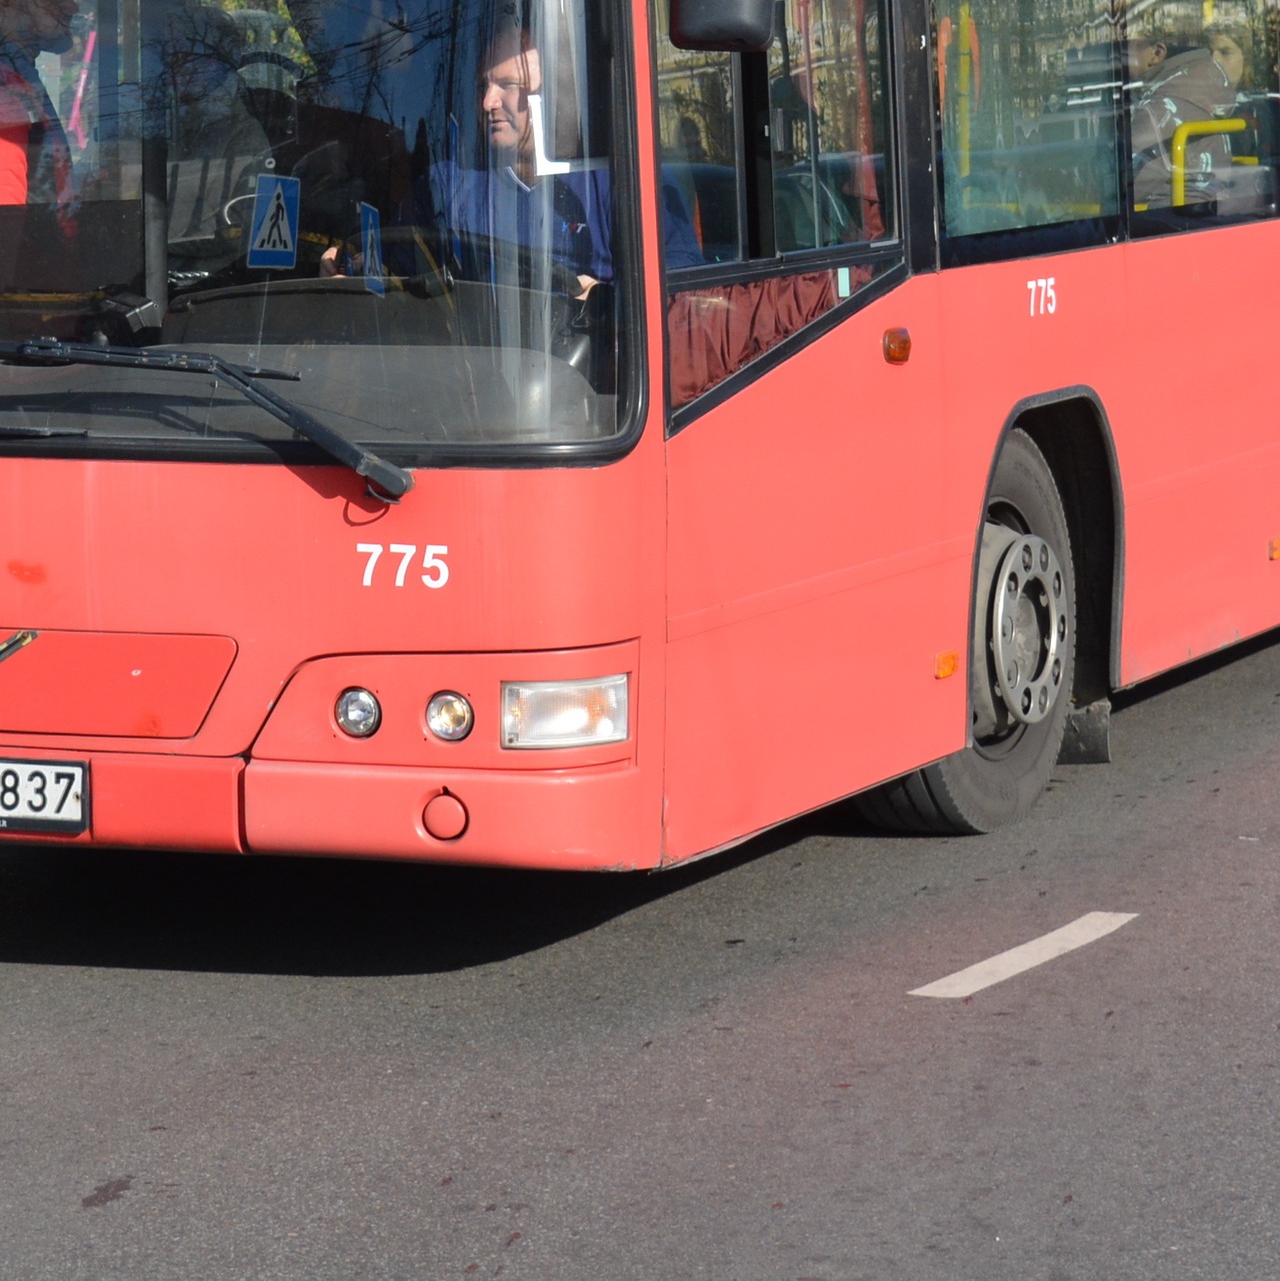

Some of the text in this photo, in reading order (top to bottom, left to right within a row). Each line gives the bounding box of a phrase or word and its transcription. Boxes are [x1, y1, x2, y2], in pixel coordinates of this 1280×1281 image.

[1027, 277, 1056, 316] 775
[356, 543, 449, 589] 775
[0, 769, 76, 814] 837
